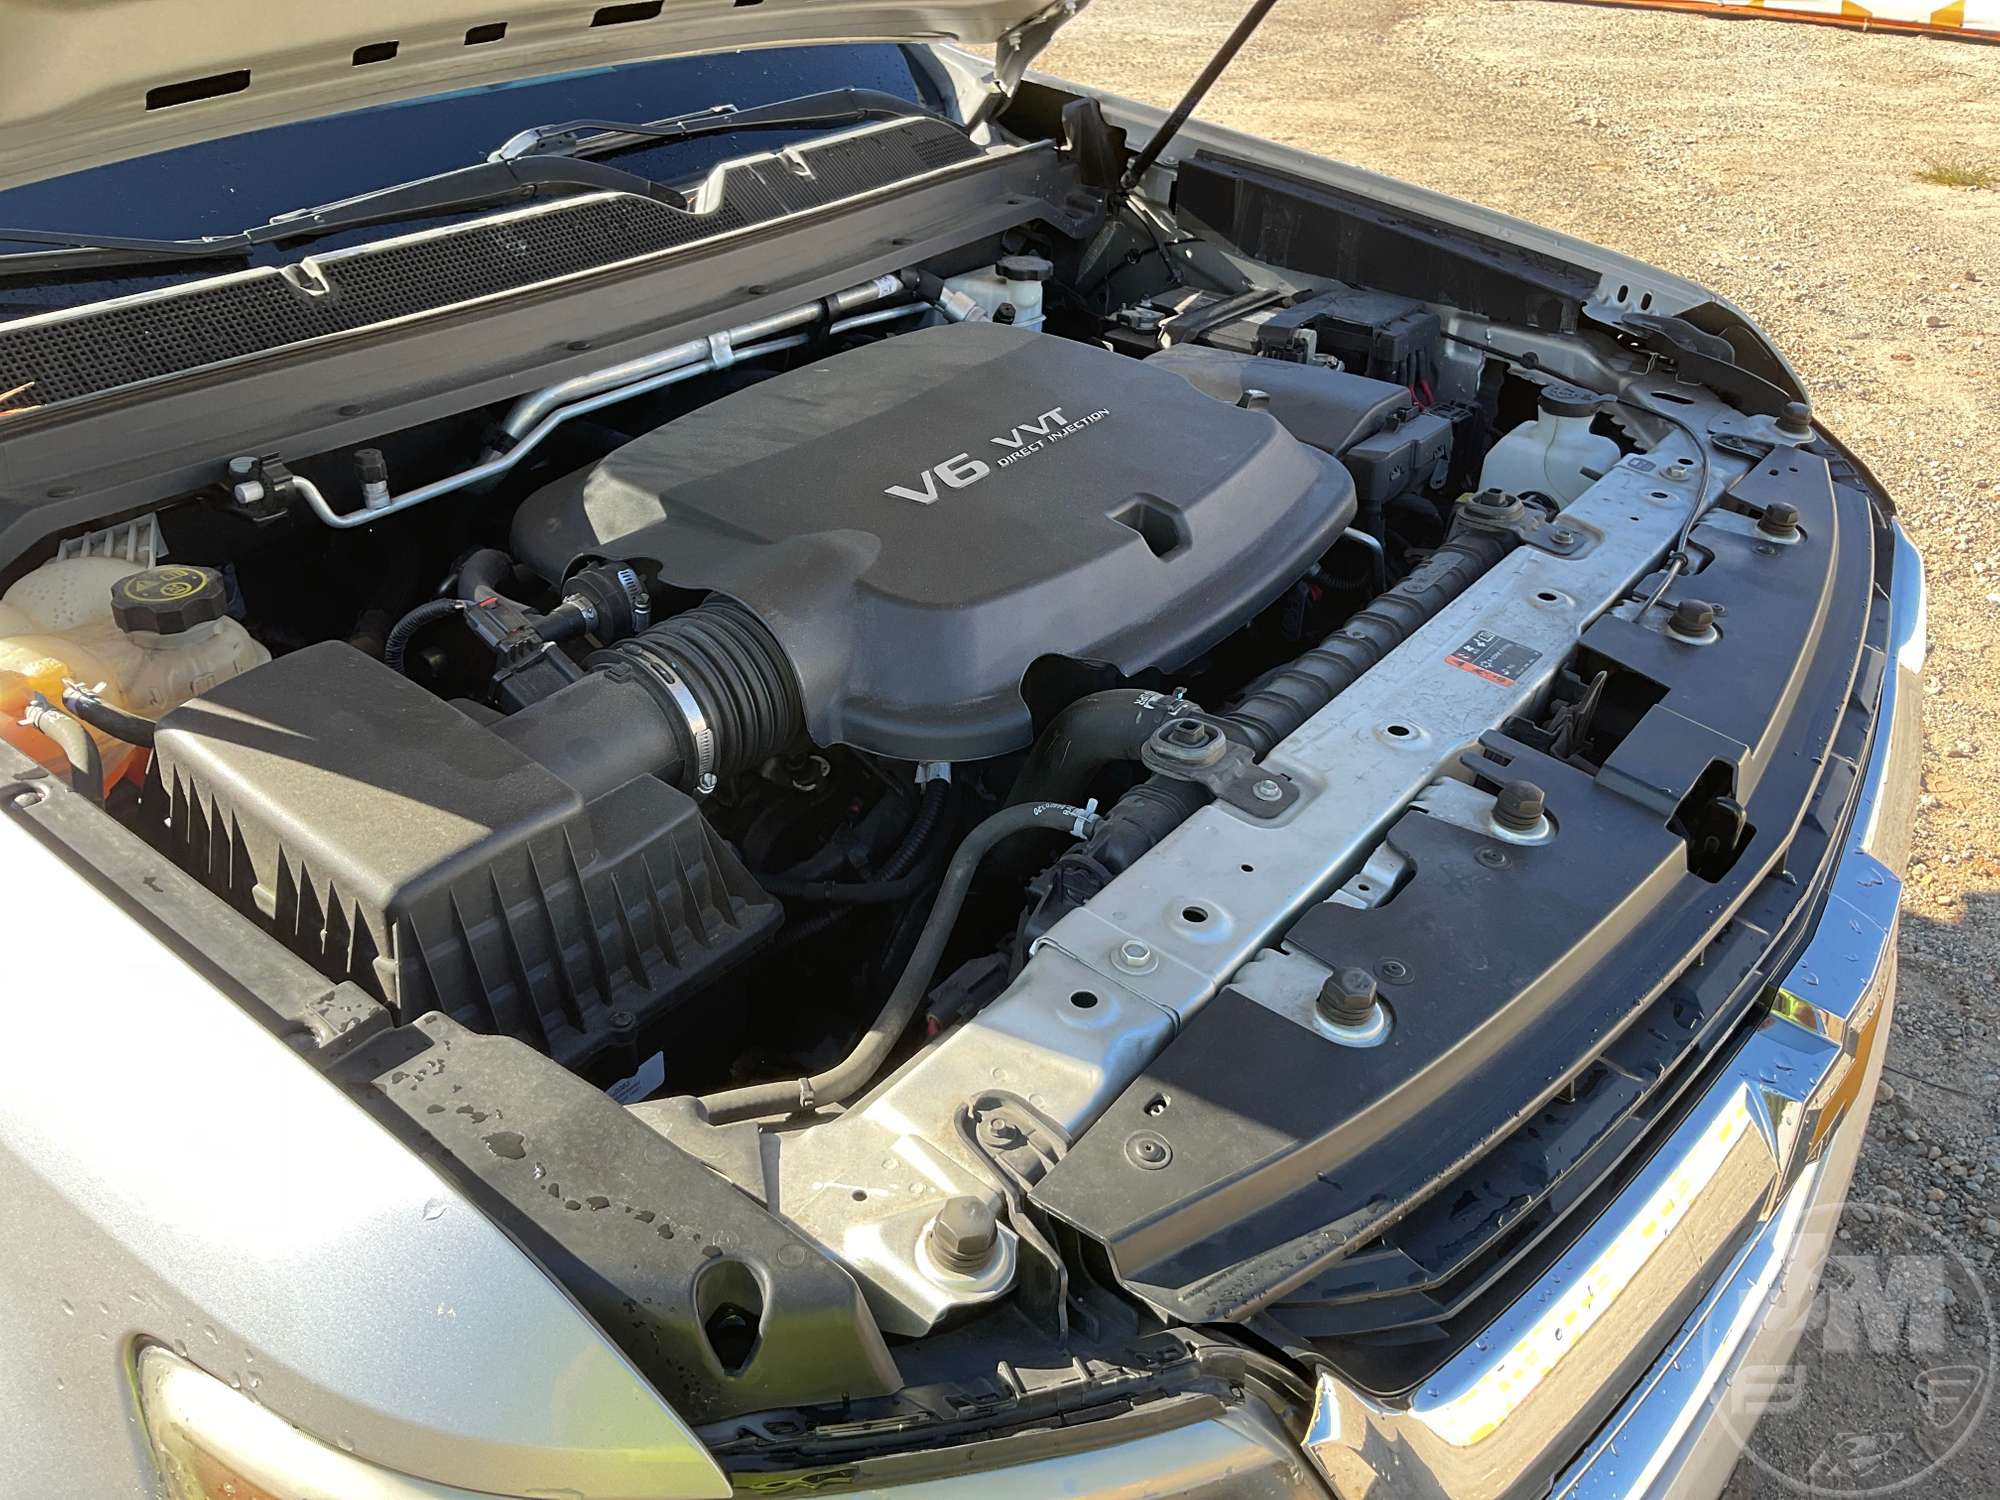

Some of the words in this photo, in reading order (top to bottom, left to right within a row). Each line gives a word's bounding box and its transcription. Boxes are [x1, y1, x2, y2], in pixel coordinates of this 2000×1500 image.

[884, 452, 991, 505] V6
[990, 406, 1068, 448] VVT
[997, 439, 1045, 468] DIRECT
[1047, 407, 1110, 443] INJECTION
